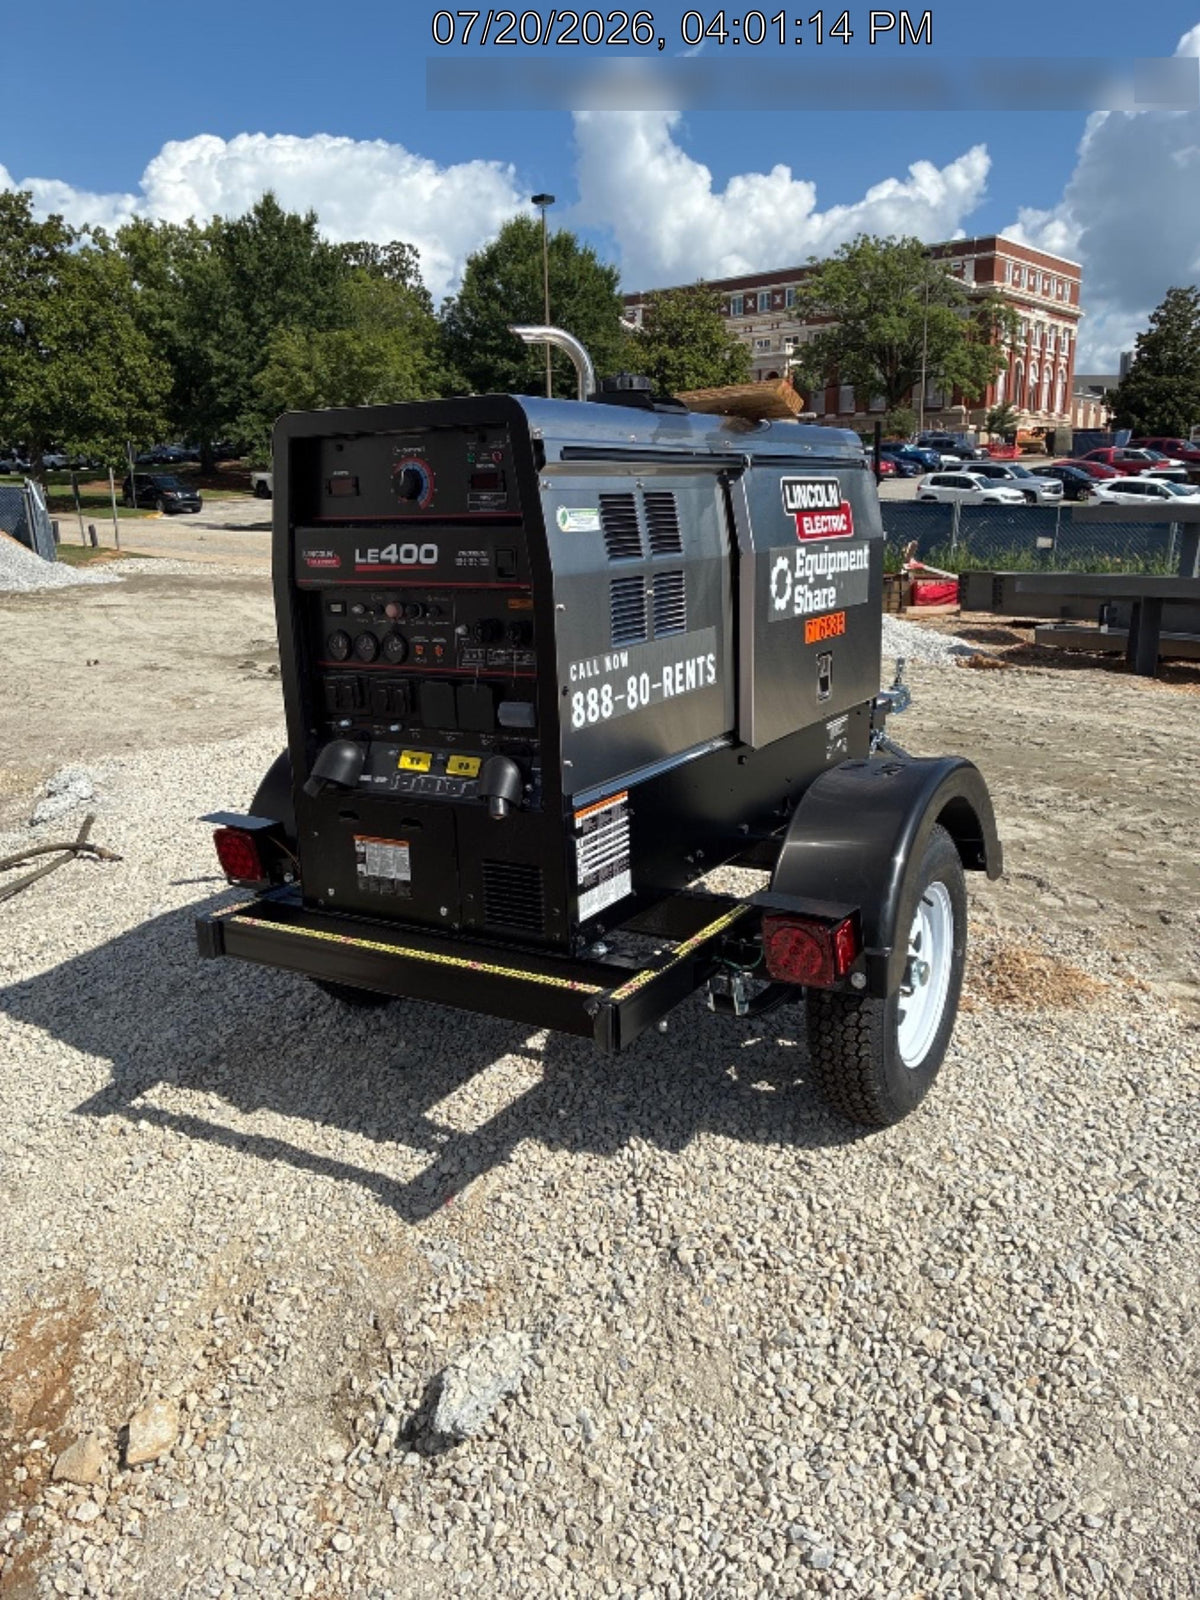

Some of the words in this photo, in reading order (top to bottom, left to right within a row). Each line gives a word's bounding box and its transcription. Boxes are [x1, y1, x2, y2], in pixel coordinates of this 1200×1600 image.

[785, 484, 839, 509] LINCOLN
[803, 514, 848, 534] ELECTRIC
[354, 543, 438, 564] LE400
[794, 545, 870, 583] Equipment
[794, 584, 836, 614] Share
[570, 659, 600, 682] CALL
[604, 651, 629, 673] NOW
[571, 652, 717, 728] 888-80-RENTS
